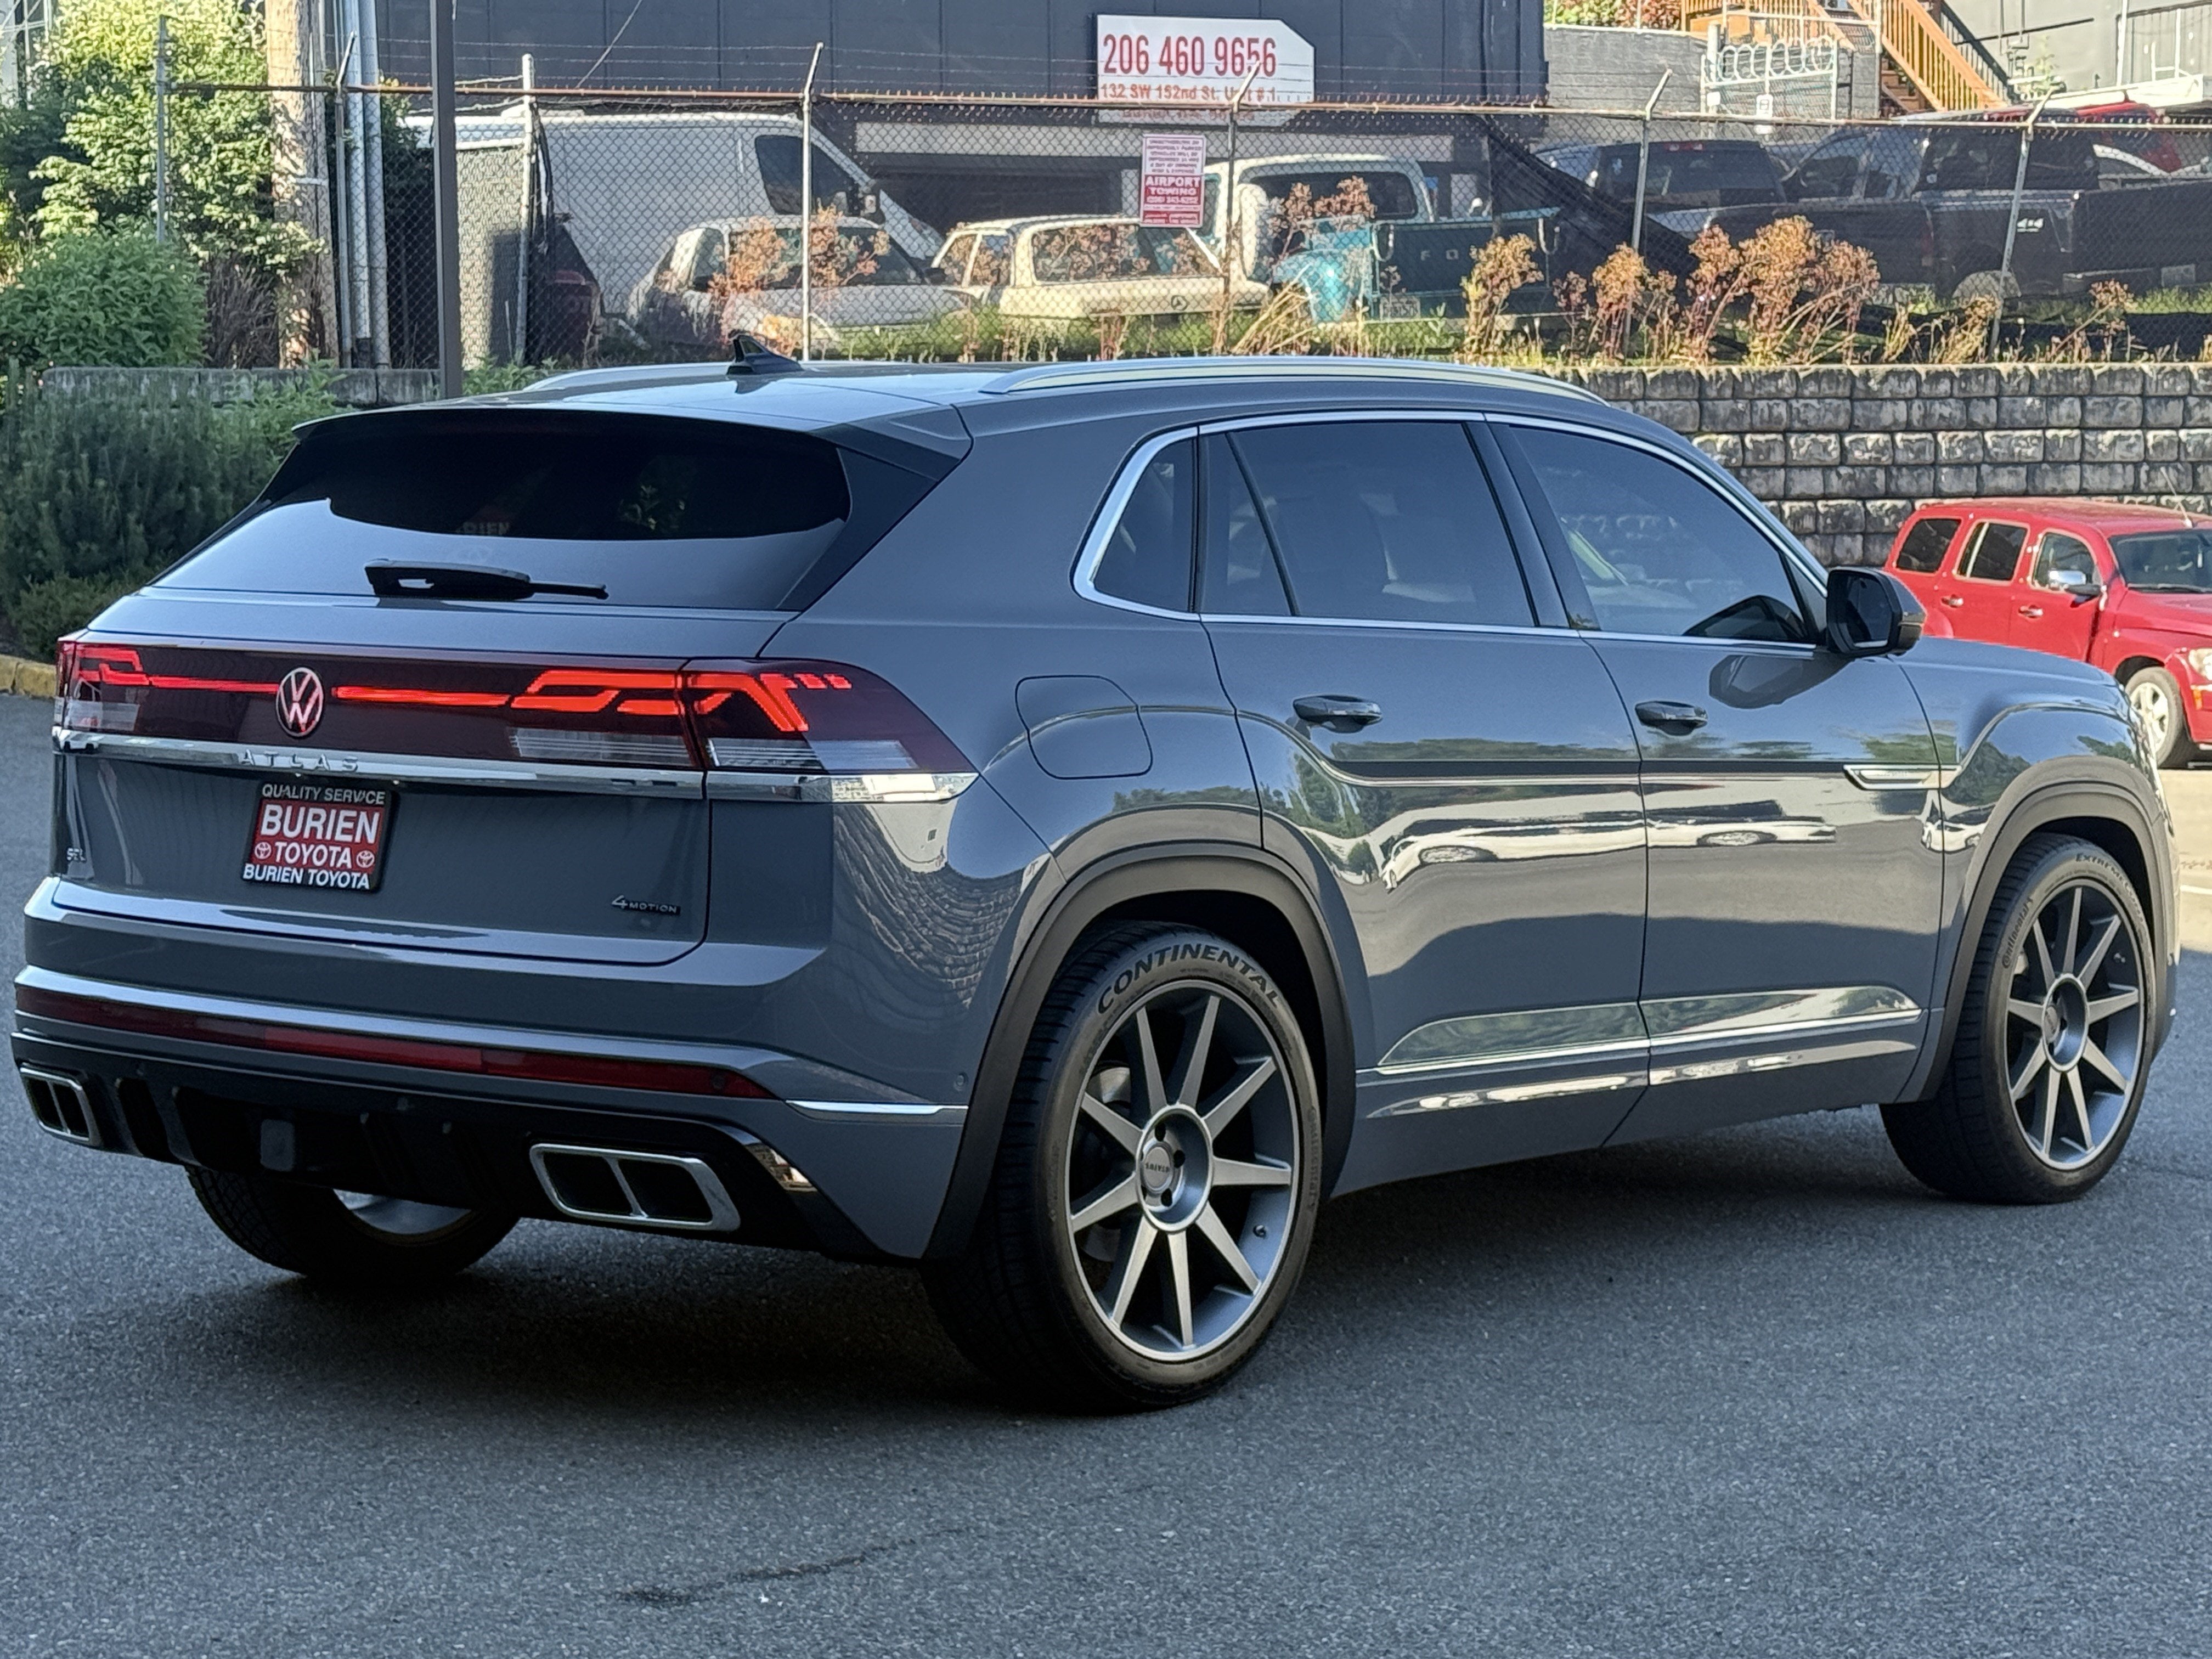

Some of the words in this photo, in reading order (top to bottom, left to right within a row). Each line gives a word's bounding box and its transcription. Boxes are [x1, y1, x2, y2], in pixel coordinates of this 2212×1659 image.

[1103, 34, 1149, 75] 206
[1159, 36, 1204, 76] 460
[1215, 37, 1276, 77] 9656
[1101, 83, 1127, 98] 132
[1130, 83, 1151, 99] SW
[1155, 84, 1197, 99] 152nd
[1146, 176, 1200, 187] AIRPORT
[239, 749, 358, 771] ATLAS
[262, 784, 321, 801] QUALITY
[324, 788, 385, 805] SERVICE
[261, 804, 380, 844] BURIEN
[274, 842, 352, 869] TOYOTA
[243, 863, 303, 884] BURIEN
[308, 870, 370, 889] TOYOTA
[611, 895, 677, 913] 4MOTION
[1098, 943, 1279, 1014] CONTINENTAL
